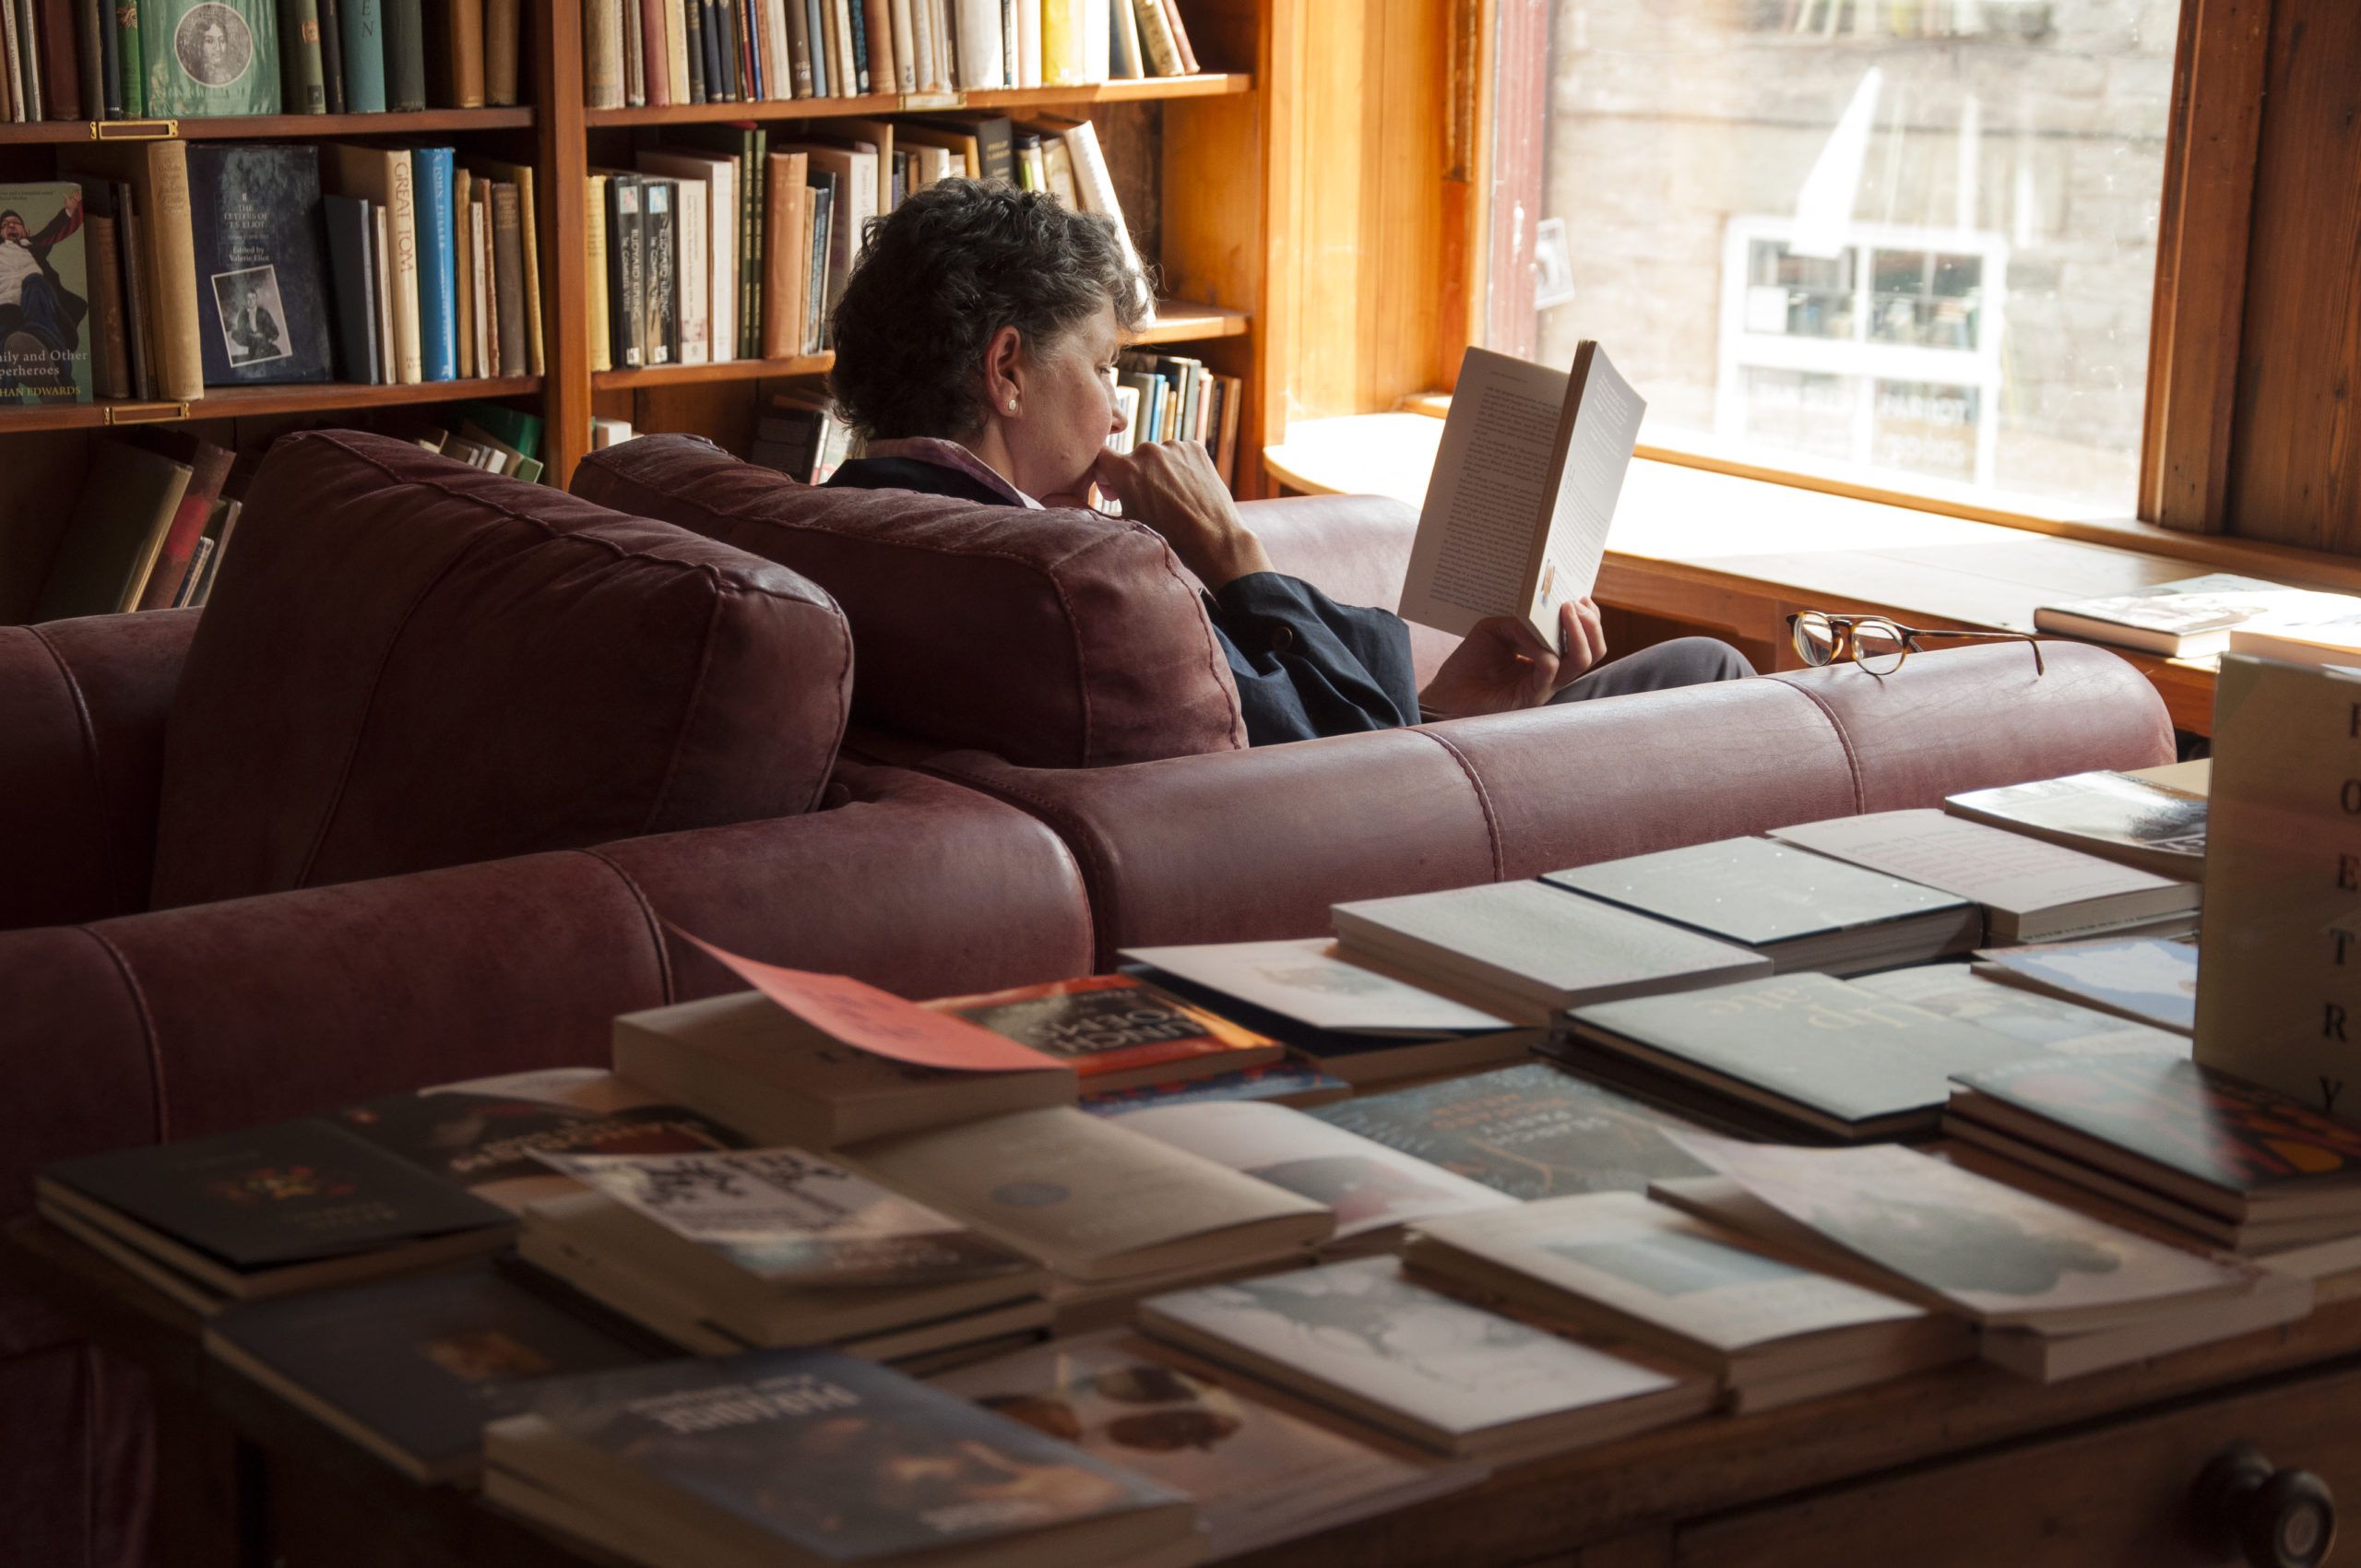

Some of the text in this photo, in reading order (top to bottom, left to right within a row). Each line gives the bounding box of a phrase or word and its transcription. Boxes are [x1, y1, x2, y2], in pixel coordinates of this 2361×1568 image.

[395, 162, 414, 273] GREAT TOM
[232, 245, 265, 255] Edited by
[229, 254, 252, 263] Valerie
[631, 229, 641, 318] RUDYARD KIPLING
[658, 229, 670, 318] RUDYARD KIPLING
[23, 350, 45, 362] and
[50, 350, 89, 362] Other
[27, 386, 81, 397] EDWARDS
